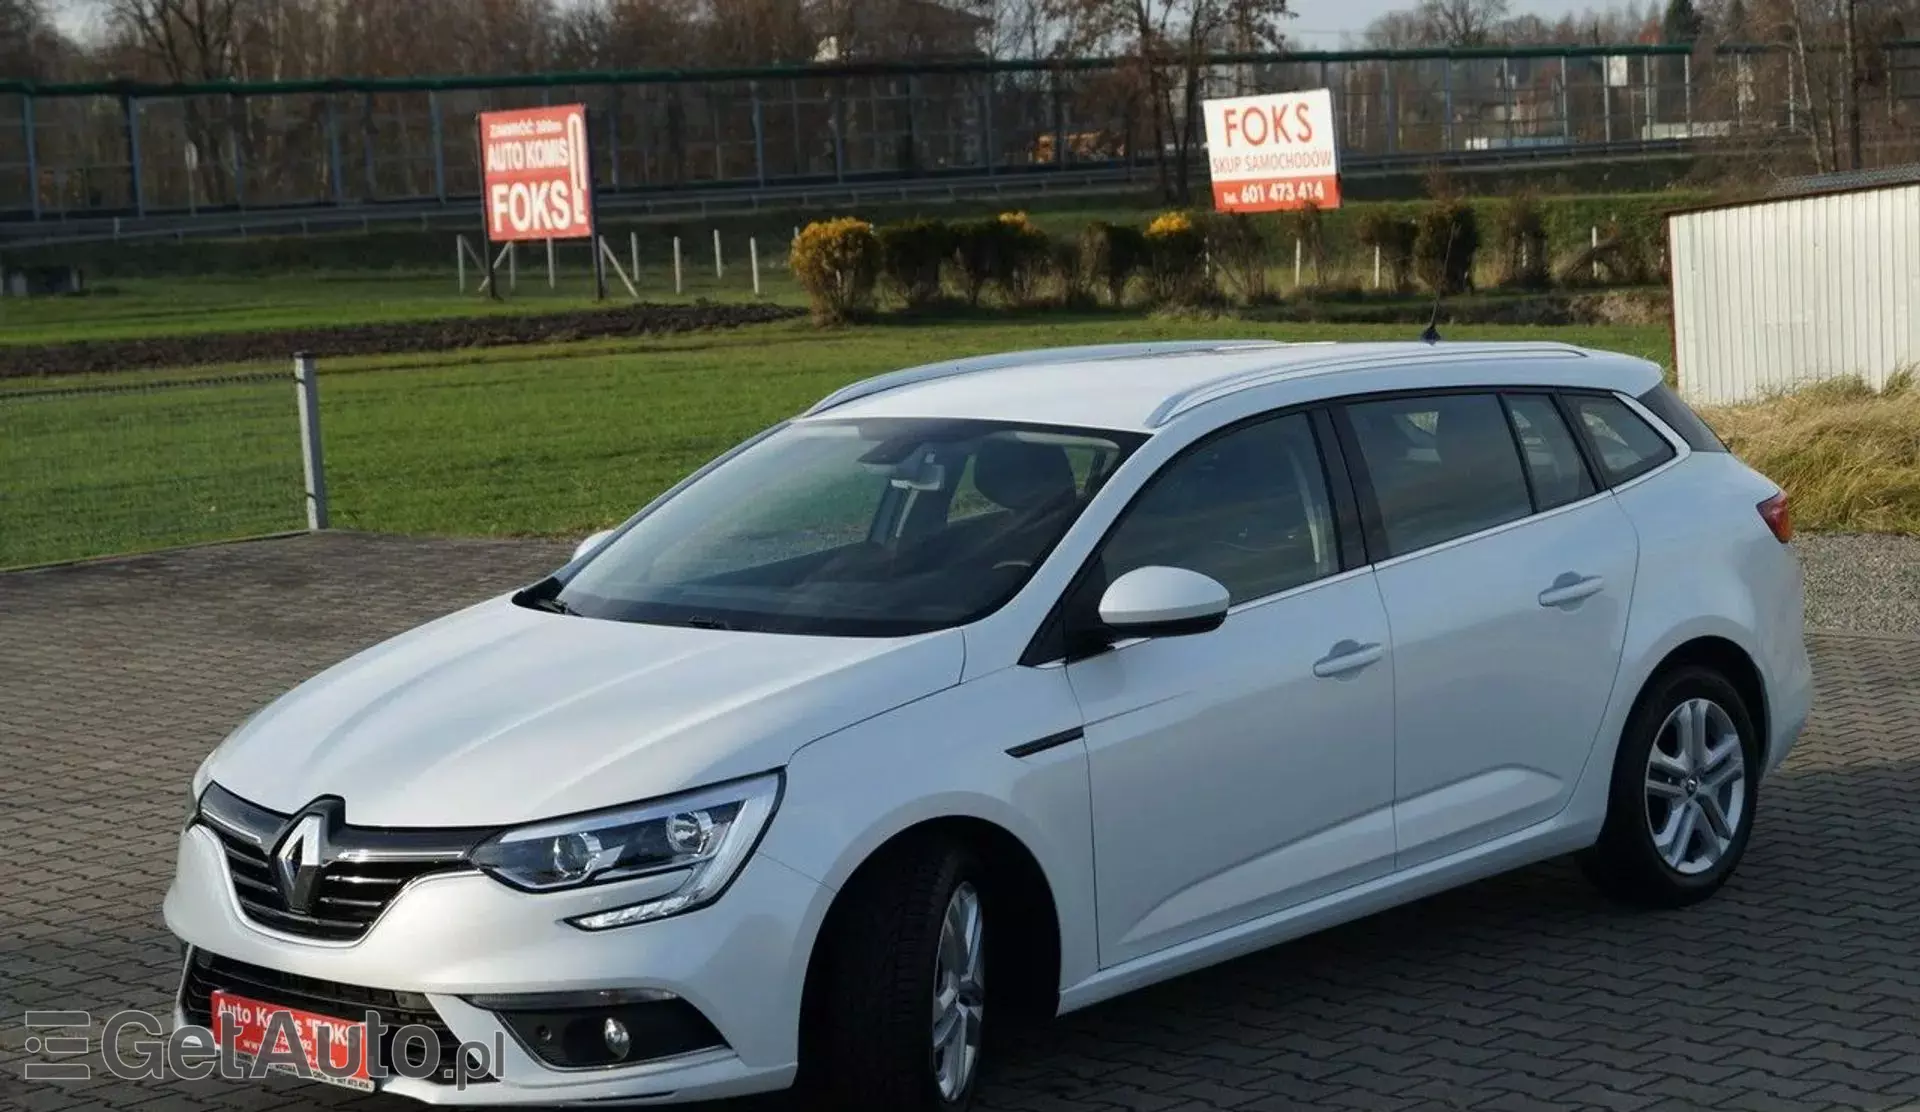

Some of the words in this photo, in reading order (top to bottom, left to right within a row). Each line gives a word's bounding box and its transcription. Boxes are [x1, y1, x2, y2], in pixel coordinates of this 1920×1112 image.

[1223, 102, 1313, 147] FOKS
[487, 141, 524, 171] AUTO
[526, 138, 569, 168] KOMIS
[1213, 156, 1241, 174] SKUP
[491, 179, 571, 232] FOKS
[1241, 183, 1265, 204] 601
[1269, 181, 1295, 202] 473
[1297, 180, 1324, 201] 414
[217, 998, 251, 1025] Auto
